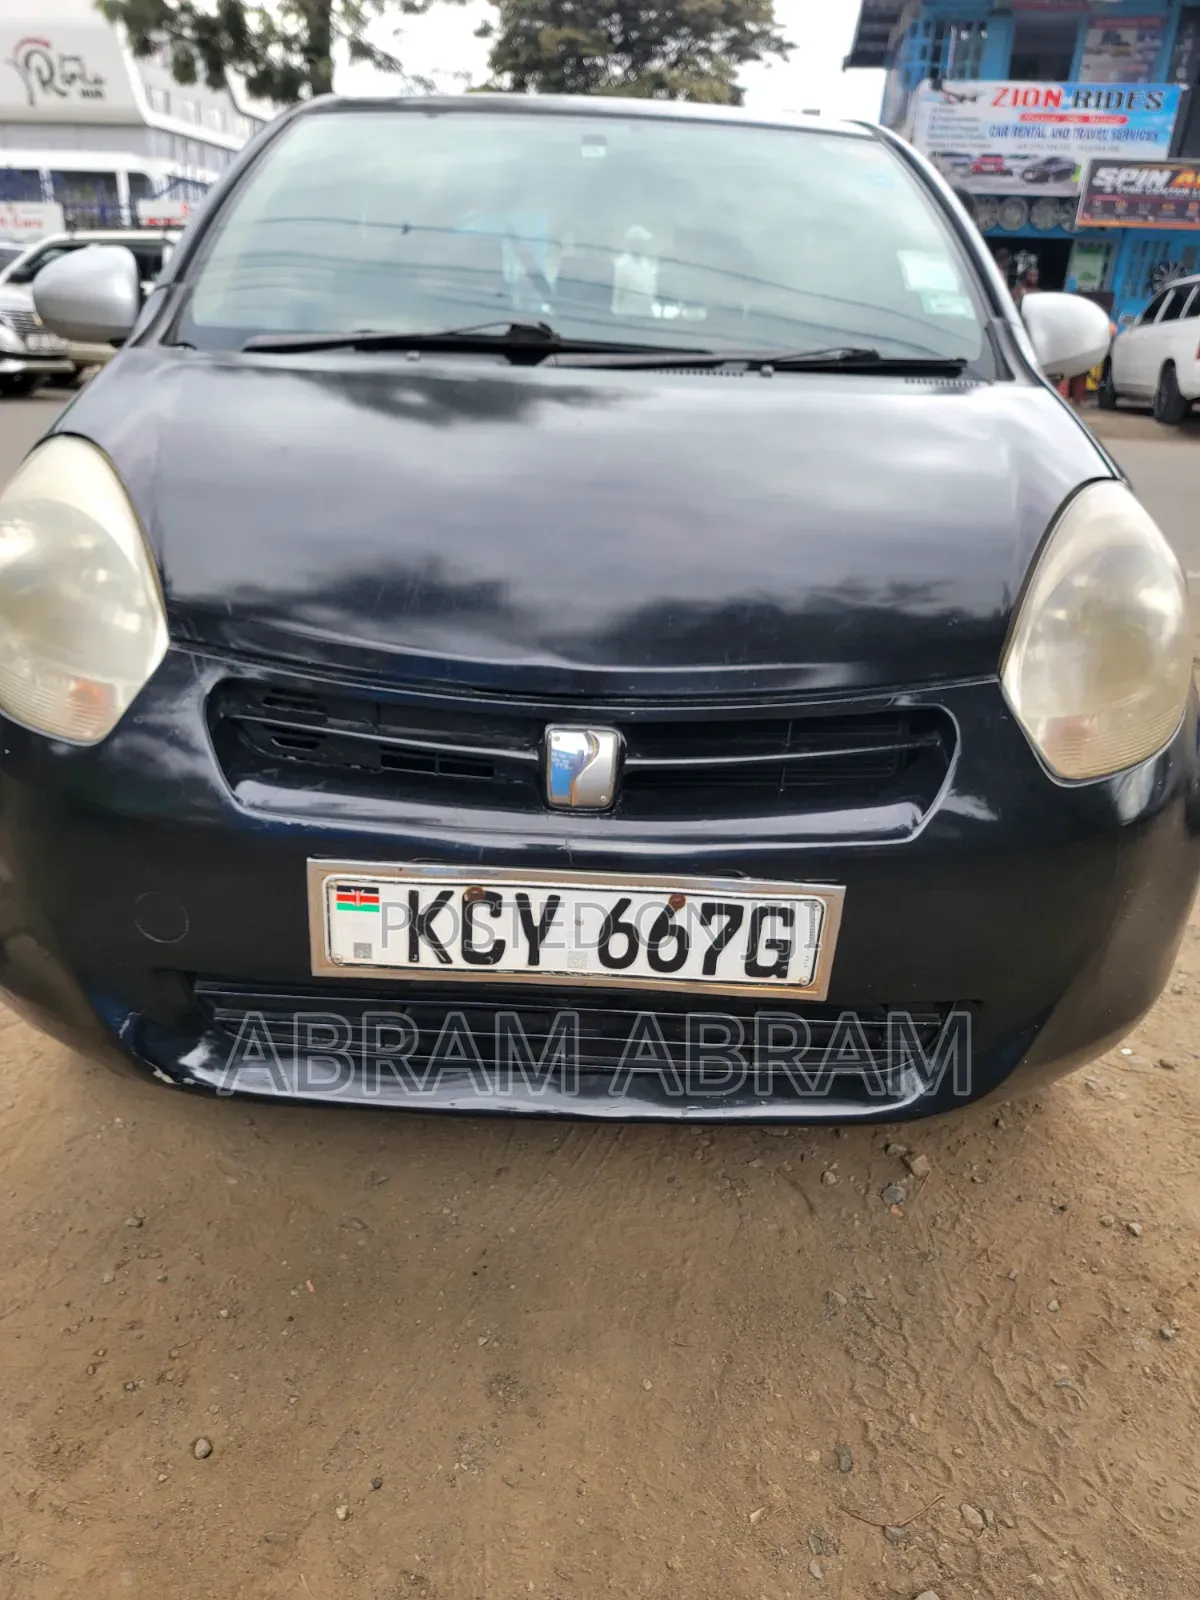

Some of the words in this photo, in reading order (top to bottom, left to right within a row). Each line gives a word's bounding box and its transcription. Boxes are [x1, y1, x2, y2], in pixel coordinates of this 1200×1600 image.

[992, 87, 1063, 109] ZION
[1072, 89, 1164, 110] RIDES
[989, 125, 1009, 139] CAR
[1011, 126, 1045, 141] RENTAL
[1050, 127, 1070, 140] AND
[1073, 127, 1108, 142] TRAVEL
[1111, 128, 1159, 143] SERVICES
[1092, 167, 1172, 190] SPIN
[408, 888, 561, 966] KCY
[599, 897, 796, 979] 667G
